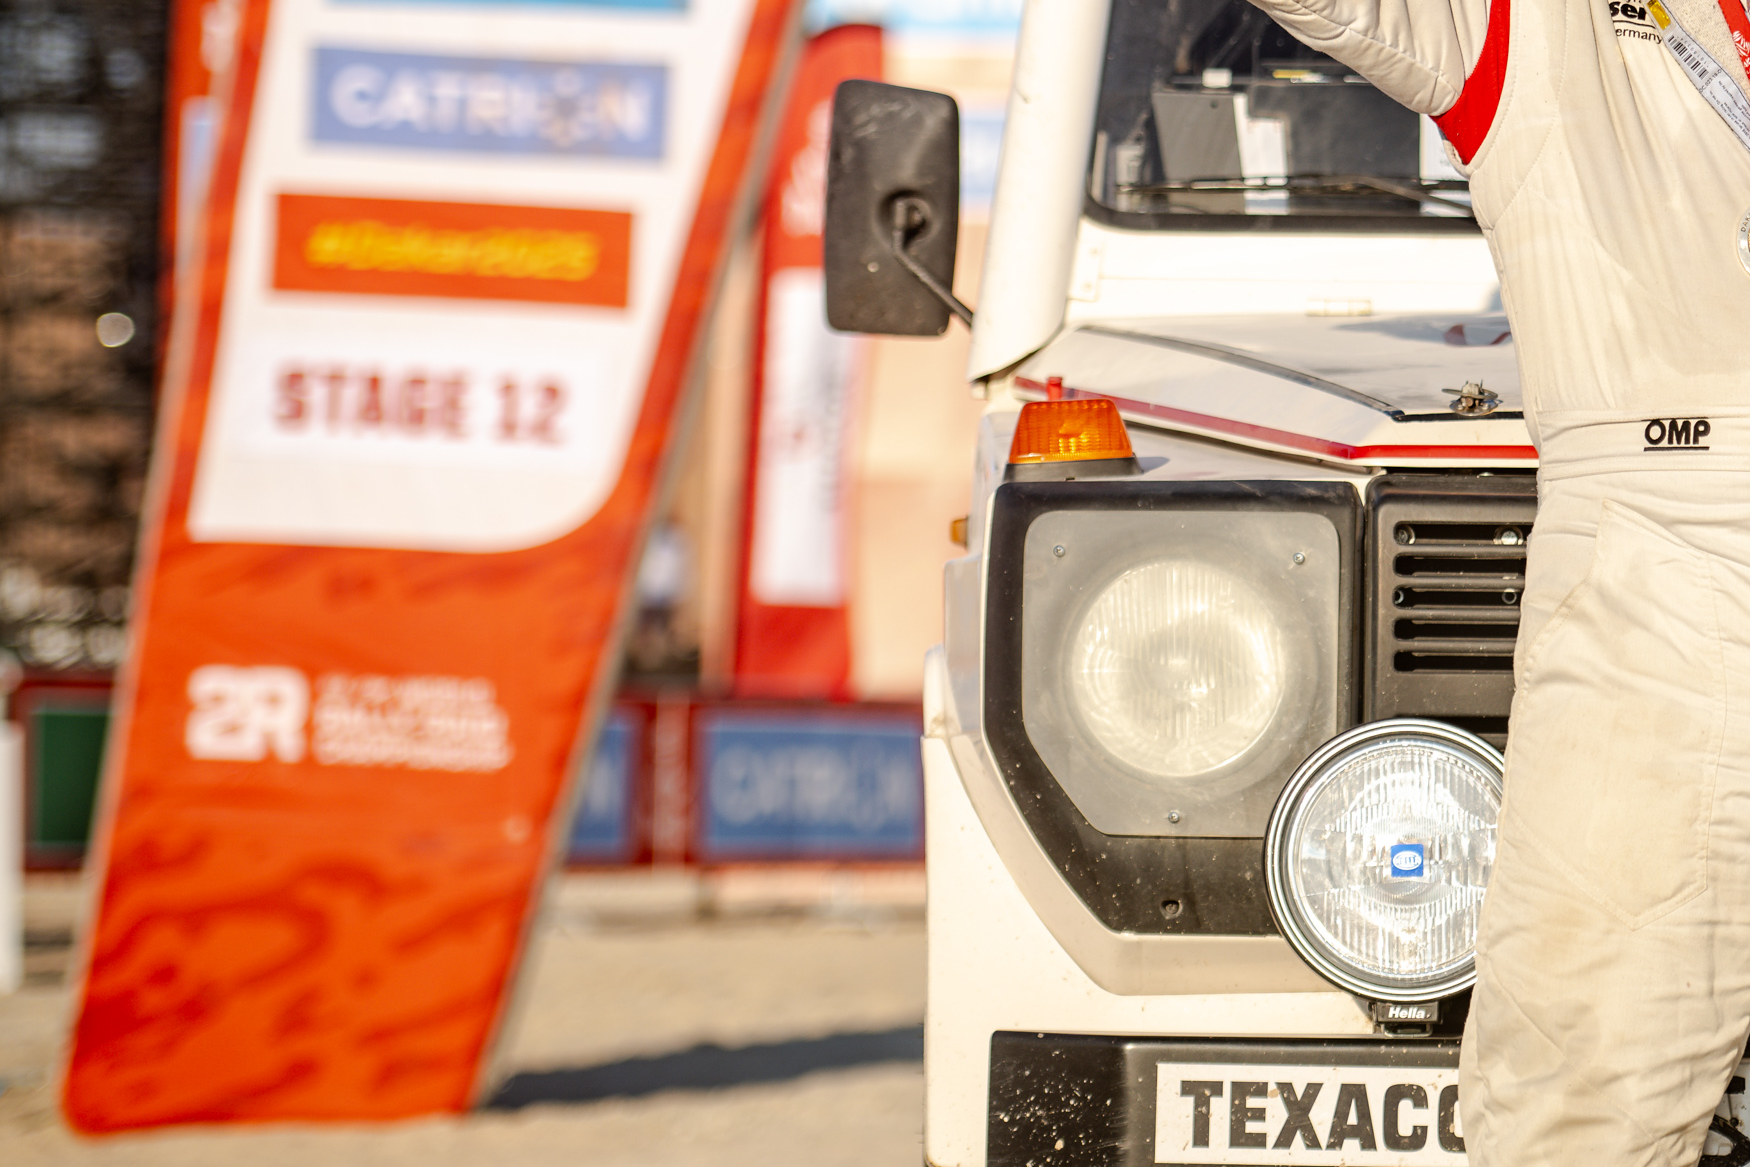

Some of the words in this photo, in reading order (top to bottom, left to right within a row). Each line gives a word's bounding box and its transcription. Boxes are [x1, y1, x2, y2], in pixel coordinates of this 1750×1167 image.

[1615, 28, 1662, 45] ermany
[273, 361, 472, 439] STAGE
[493, 372, 572, 445] 12
[1645, 419, 1710, 446] OMP
[184, 663, 310, 763] 2R
[1388, 1006, 1427, 1020] Hella
